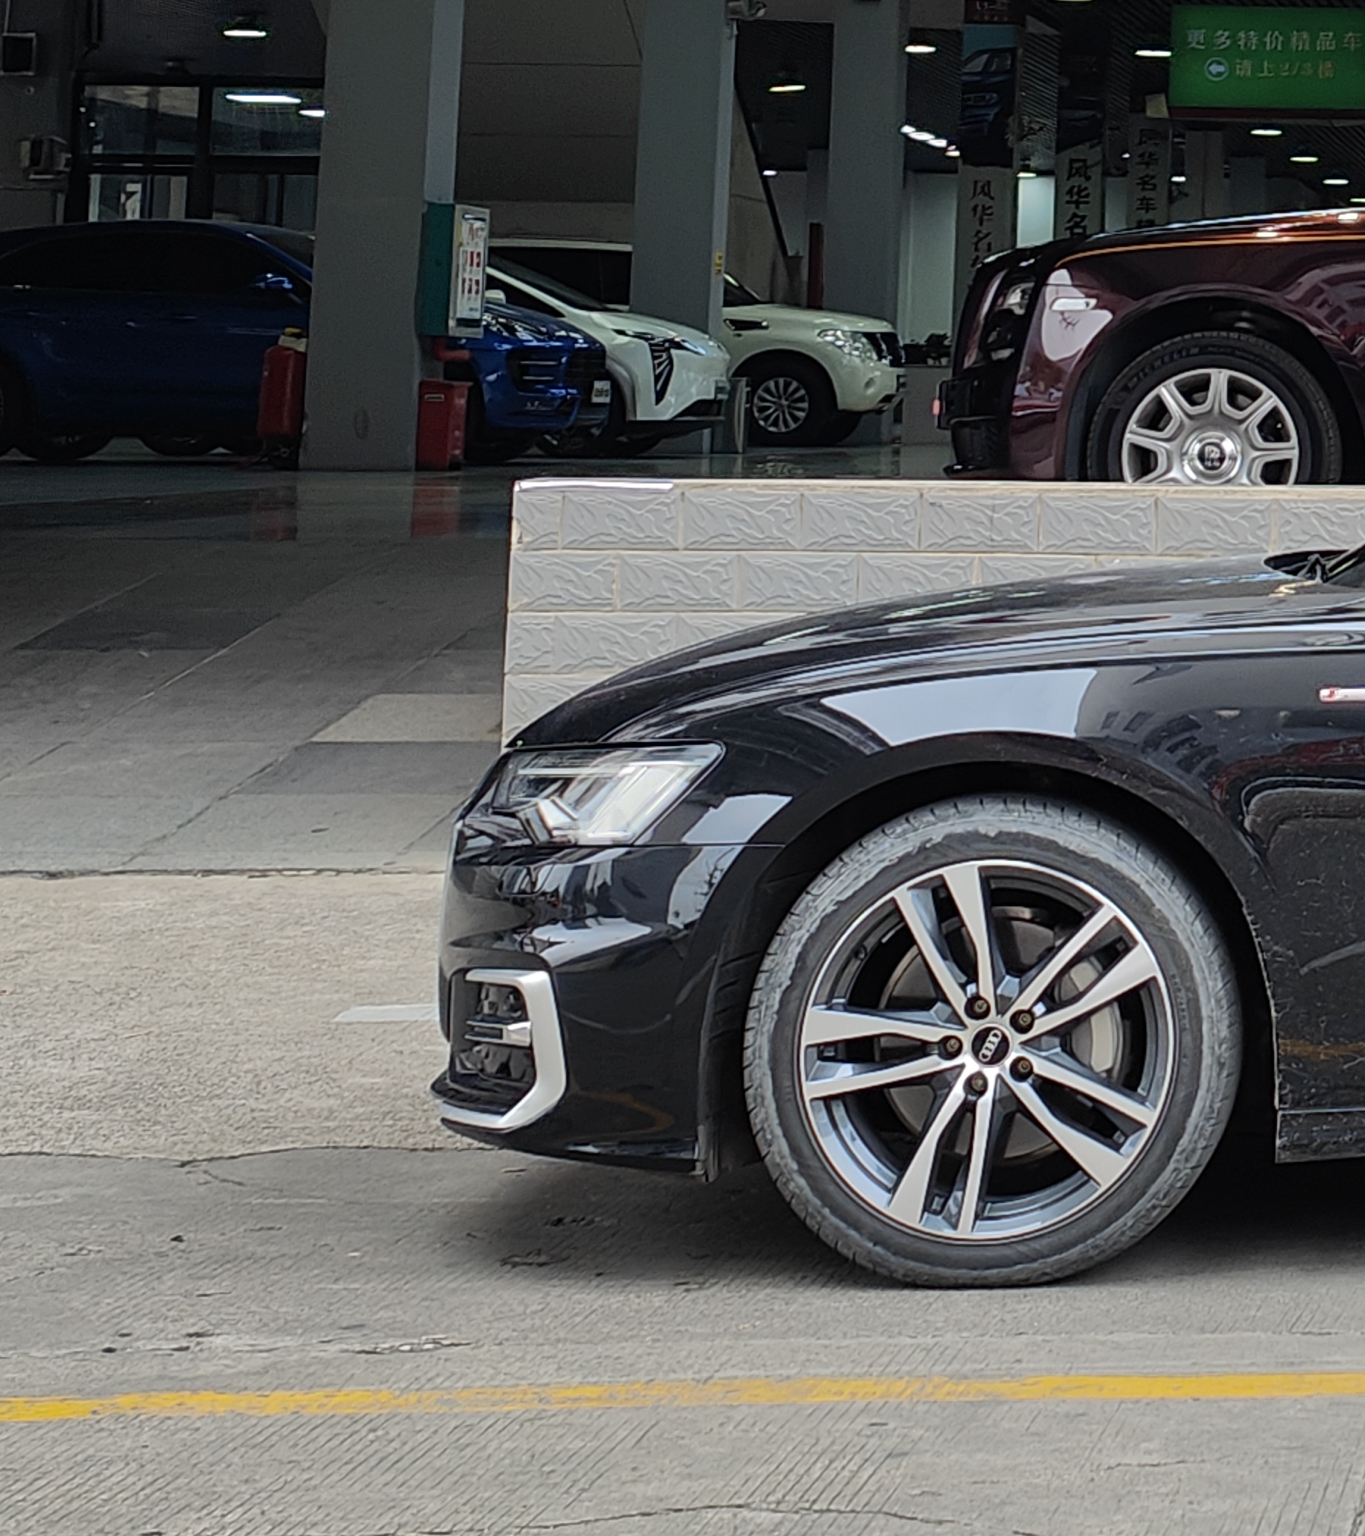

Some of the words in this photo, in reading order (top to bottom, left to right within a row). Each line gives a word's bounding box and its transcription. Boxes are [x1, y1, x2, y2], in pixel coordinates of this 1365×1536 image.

[1186, 29, 1363, 52] 更多特价精品车
